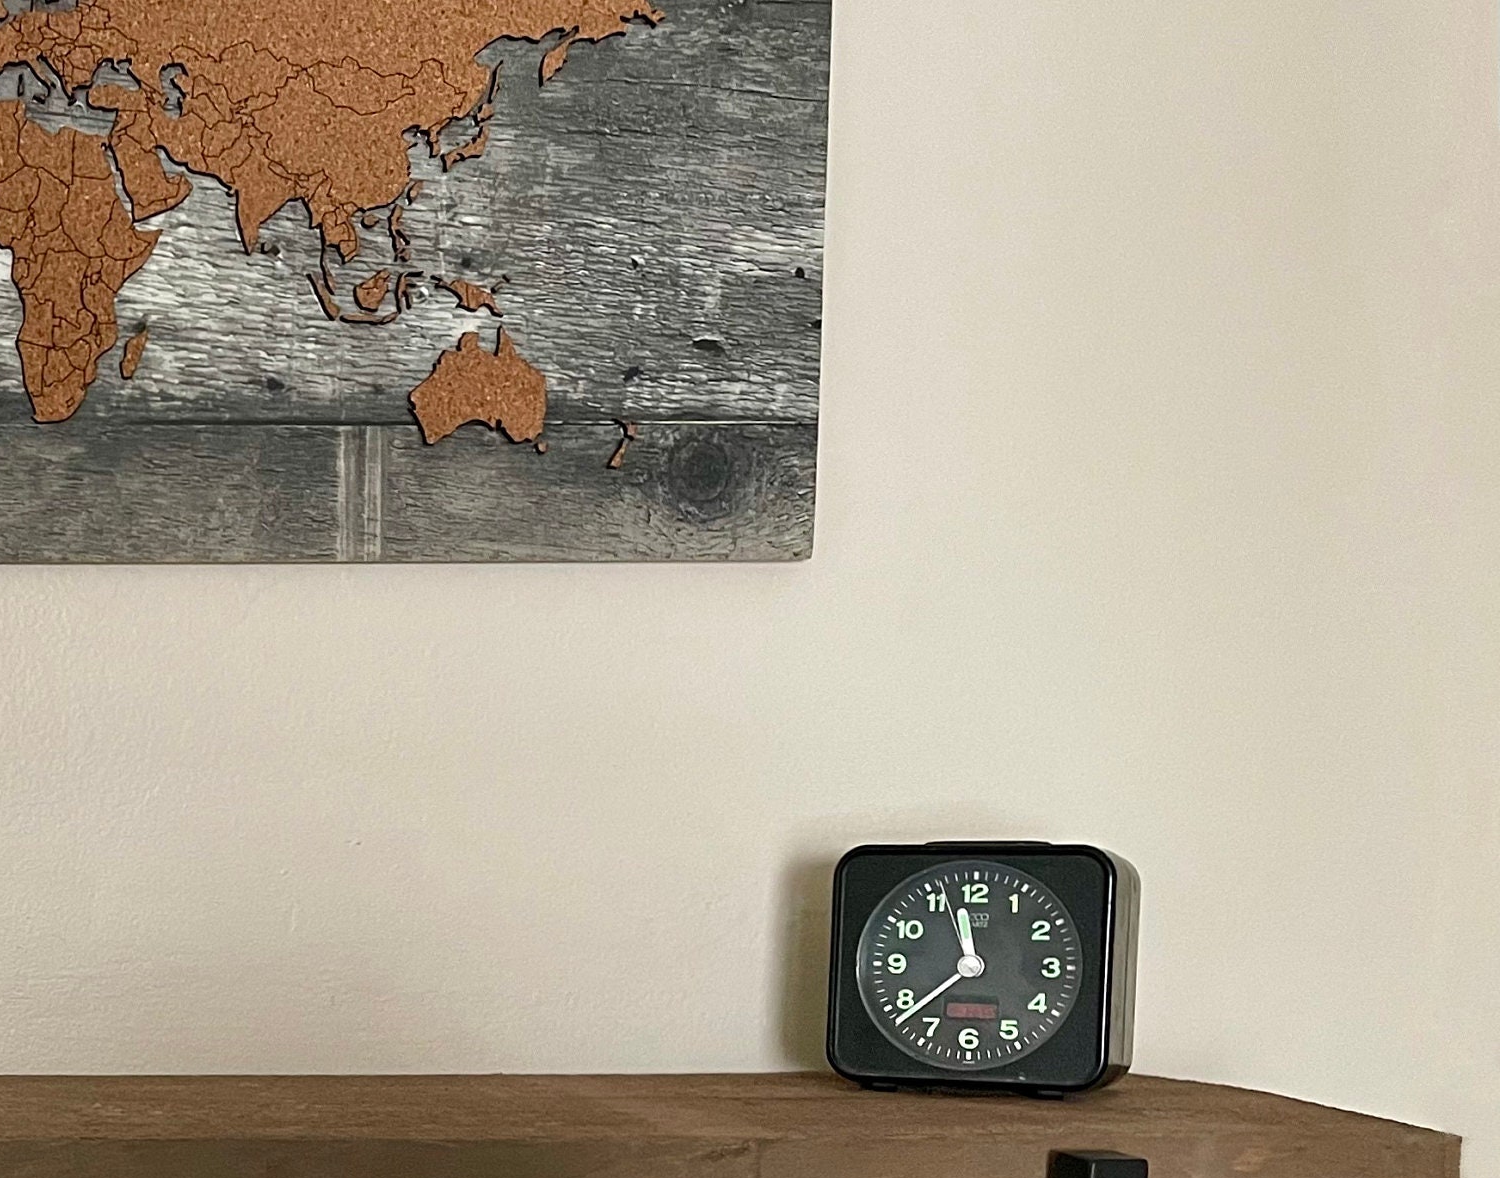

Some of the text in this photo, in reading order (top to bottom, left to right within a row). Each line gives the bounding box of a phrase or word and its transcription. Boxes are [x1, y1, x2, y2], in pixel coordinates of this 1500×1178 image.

[927, 893, 946, 912] 11
[962, 884, 989, 903] 12
[1008, 894, 1019, 913] 1
[896, 920, 923, 940] 10
[1031, 921, 1051, 940] 2
[888, 953, 907, 974] 9
[1042, 957, 1061, 978] 3
[897, 989, 915, 1010] 8
[1027, 992, 1048, 1014] 4
[922, 1017, 940, 1037] 7
[1000, 1020, 1019, 1040] 5
[958, 1028, 980, 1050] 6
